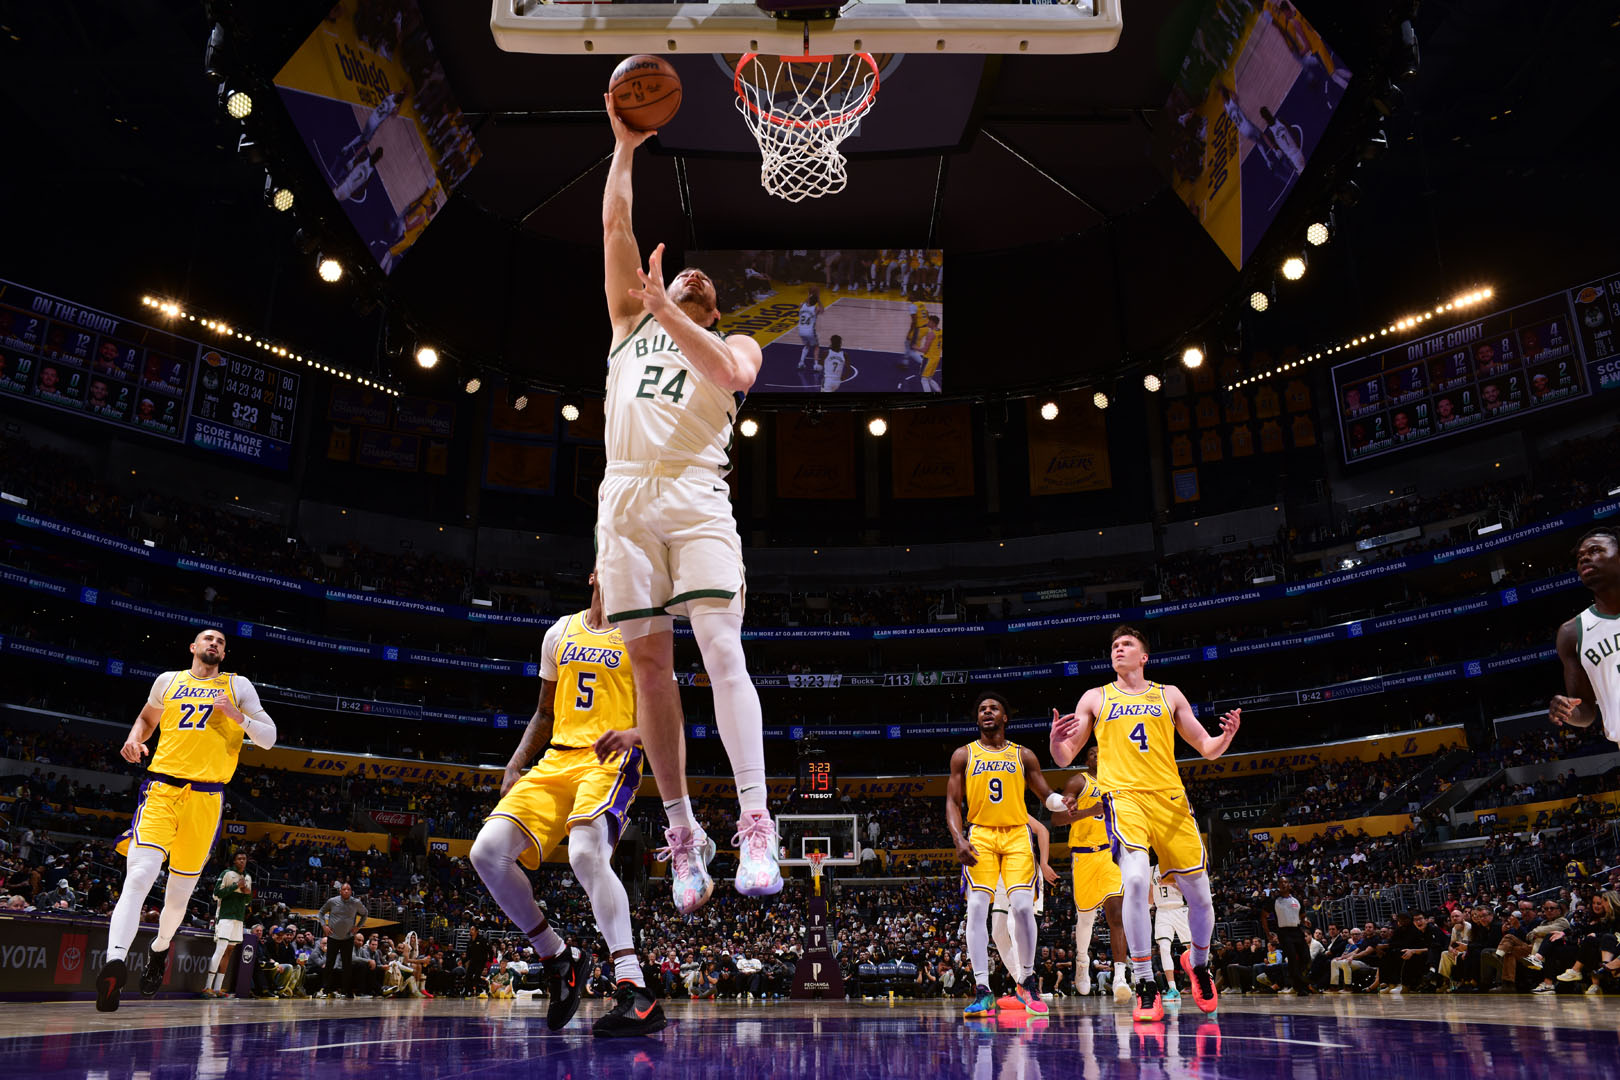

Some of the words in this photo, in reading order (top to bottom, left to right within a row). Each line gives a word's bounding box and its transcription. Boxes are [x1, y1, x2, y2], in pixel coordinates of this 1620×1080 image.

[336, 43, 390, 101] bibigo
[614, 62, 659, 80] Wilson
[1209, 111, 1233, 201] bibigo
[32, 296, 53, 314] ON
[53, 302, 78, 322] THE
[77, 310, 120, 336] COURT
[800, 314, 811, 326] 24
[27, 319, 38, 332] 2
[1550, 322, 1558, 336] 4
[77, 333, 91, 348] 12
[1408, 342, 1424, 360] ON
[1424, 336, 1444, 356] THE
[1446, 322, 1484, 348] COURT
[1502, 338, 1510, 352] 8
[127, 349, 136, 362] 8
[1453, 352, 1465, 367] 12
[18, 358, 32, 372] 10
[173, 363, 182, 376] 4
[832, 362, 838, 372] 7
[1558, 362, 1567, 377] 2
[71, 373, 81, 388] 0
[231, 360, 241, 375] 19
[241, 364, 252, 378] 27
[254, 368, 266, 382] 23
[282, 376, 294, 392] 80
[1412, 367, 1418, 380] 2
[636, 365, 688, 403] 24
[1509, 376, 1517, 392] 2
[120, 387, 130, 401] 2
[226, 378, 238, 393] 34
[238, 382, 250, 398] 23
[251, 388, 262, 401] 34
[278, 394, 294, 411] 113
[1462, 391, 1470, 405] 0
[168, 401, 176, 414] 2
[232, 402, 259, 424] 3:23
[1416, 404, 1427, 418] 10
[1375, 418, 1382, 430] 2
[195, 423, 232, 440] SCORE
[234, 433, 263, 448] MORE
[194, 432, 262, 458] #WITHAMEX
[1593, 504, 1616, 516] LEARN
[17, 513, 40, 525] LEARN
[41, 520, 60, 531] MORE
[62, 526, 70, 534] AT
[1433, 551, 1455, 561] LEARN
[1456, 545, 1474, 556] MORE
[1475, 542, 1483, 550] AT
[178, 558, 198, 568] LEARN
[200, 562, 218, 572] MORE
[1286, 584, 1306, 593] LEARN
[1306, 580, 1324, 590] MORE
[326, 590, 346, 598] LEARN
[1145, 608, 1164, 616] LEARN
[560, 642, 622, 668] LAKERS
[794, 676, 824, 688] 3:23
[851, 677, 874, 685] Bucks
[889, 674, 910, 686] 113
[575, 672, 596, 711] 5
[1302, 691, 1321, 702] 9:42
[341, 700, 360, 711] 9:42
[1106, 702, 1162, 722] LAKERS
[178, 704, 214, 730] 27
[1128, 722, 1149, 753] 4
[304, 758, 347, 772] LOS
[358, 763, 448, 781] ANGELES
[808, 762, 830, 772] 3:23
[972, 760, 1016, 776] LAKERS
[1178, 762, 1226, 776] ELES
[1232, 752, 1320, 772] LAKERS
[812, 773, 828, 791] 19
[842, 782, 924, 794] LAKERS
[988, 778, 1003, 804] 9
[376, 812, 408, 824] Coca-Cola
[228, 825, 245, 833] 105
[432, 842, 447, 852] 106
[1158, 886, 1168, 898] 13
[0, 945, 47, 969] YOTA
[90, 950, 144, 972] TOTA
